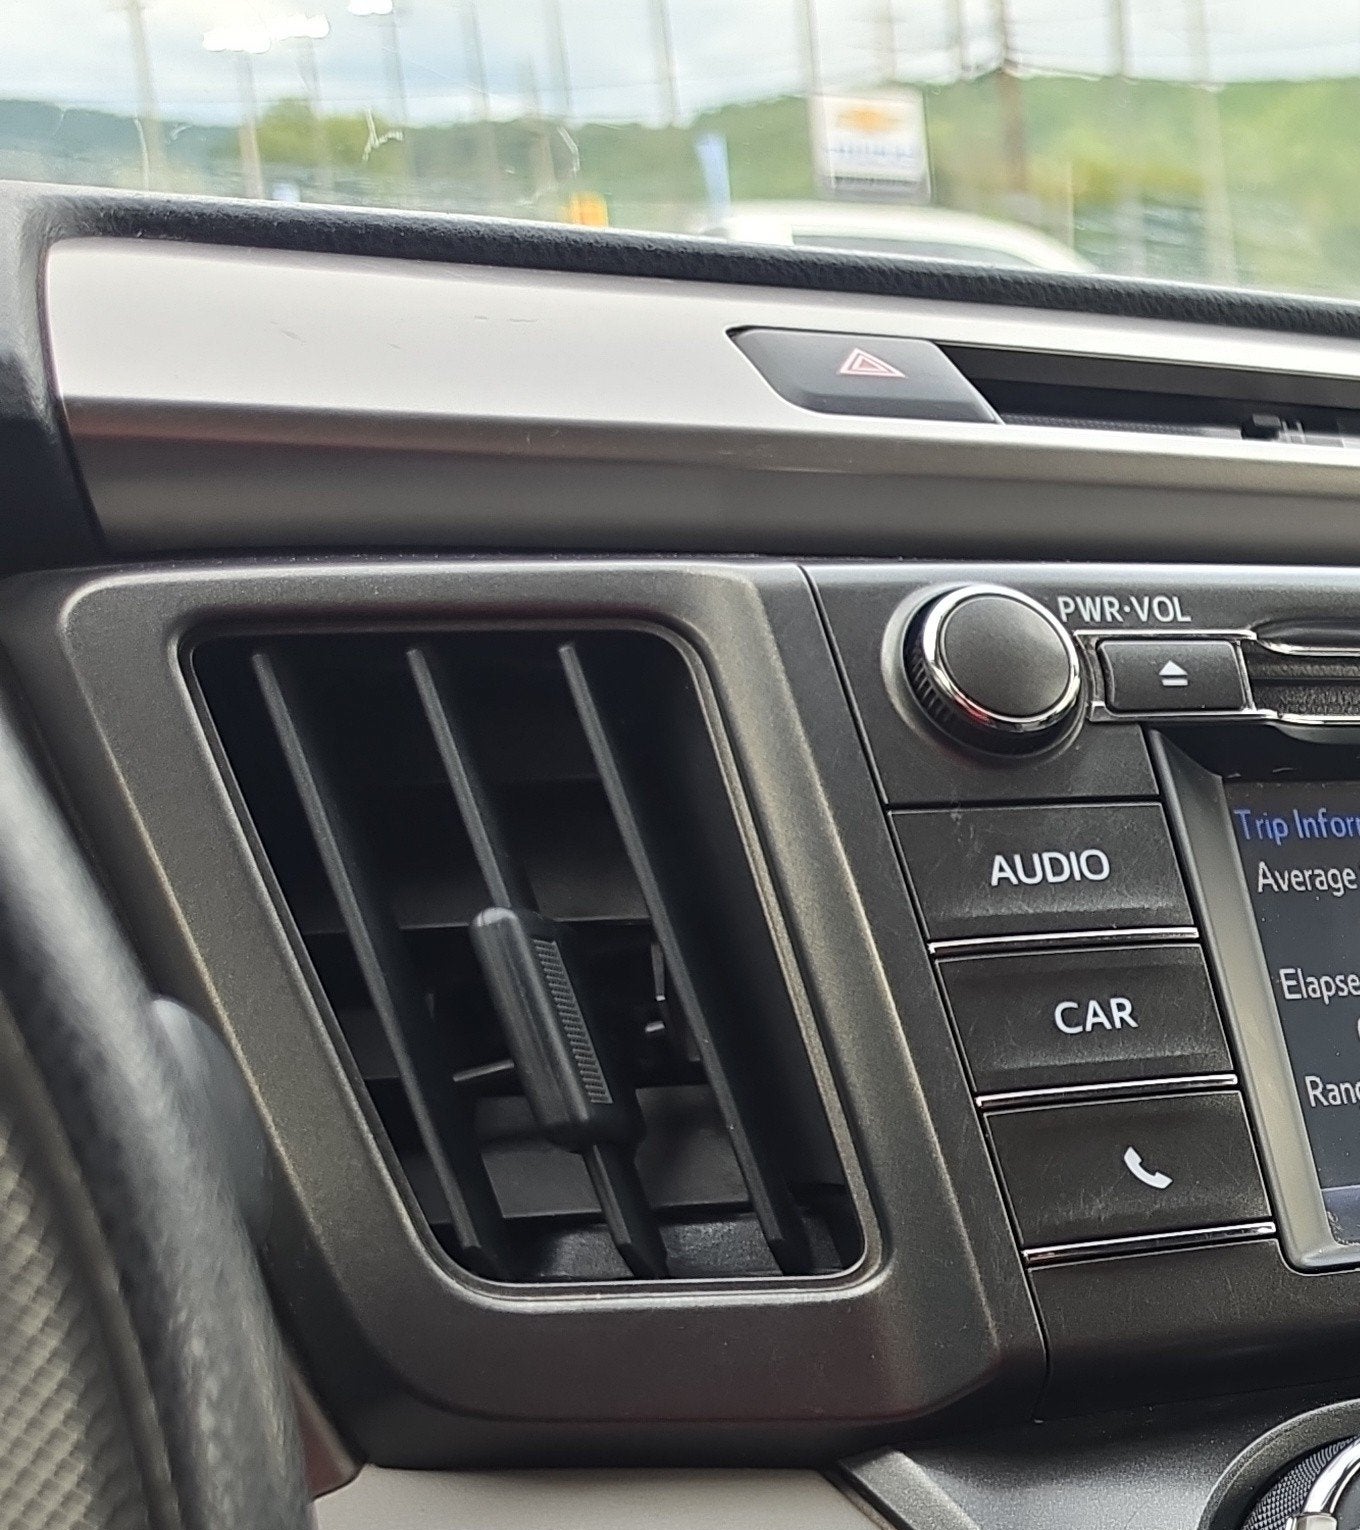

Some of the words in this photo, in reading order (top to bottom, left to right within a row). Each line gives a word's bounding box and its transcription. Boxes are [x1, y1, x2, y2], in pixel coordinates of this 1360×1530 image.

[1233, 807, 1291, 846] Trip
[990, 847, 1110, 887] AUDIO
[1256, 859, 1354, 898] Average
[1052, 997, 1139, 1035] CAR
